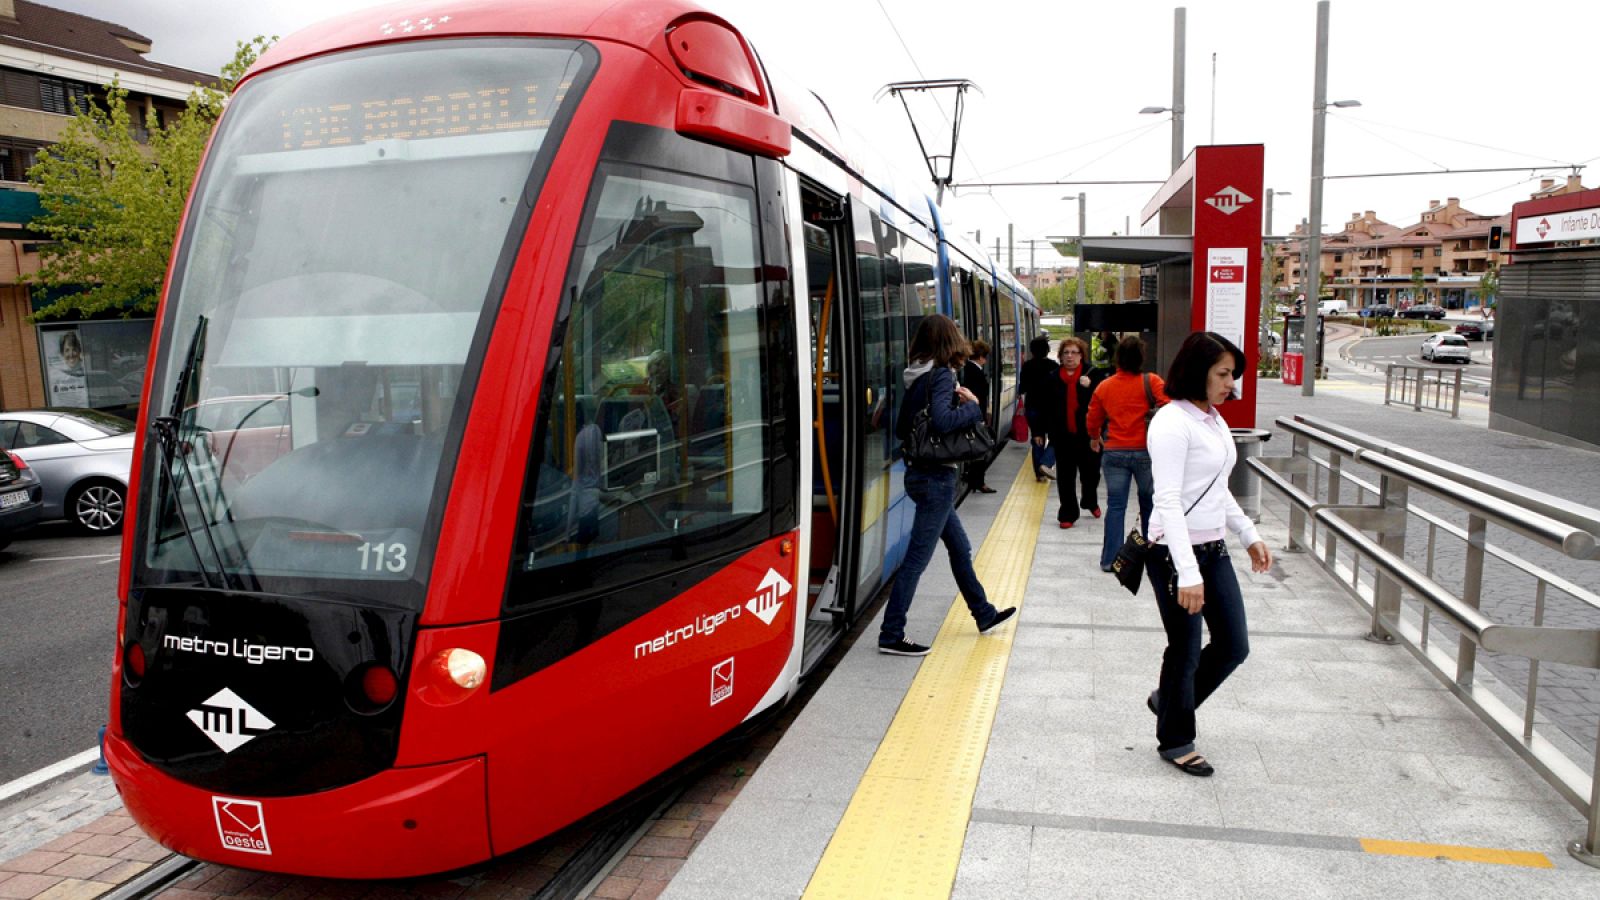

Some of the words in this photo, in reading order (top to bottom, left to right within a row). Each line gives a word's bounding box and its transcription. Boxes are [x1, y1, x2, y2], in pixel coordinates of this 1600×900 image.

[1560, 216, 1588, 232] Infante
[357, 542, 407, 573] 113
[163, 634, 229, 657] metro
[634, 623, 694, 660] metro
[225, 835, 265, 849] oeste
